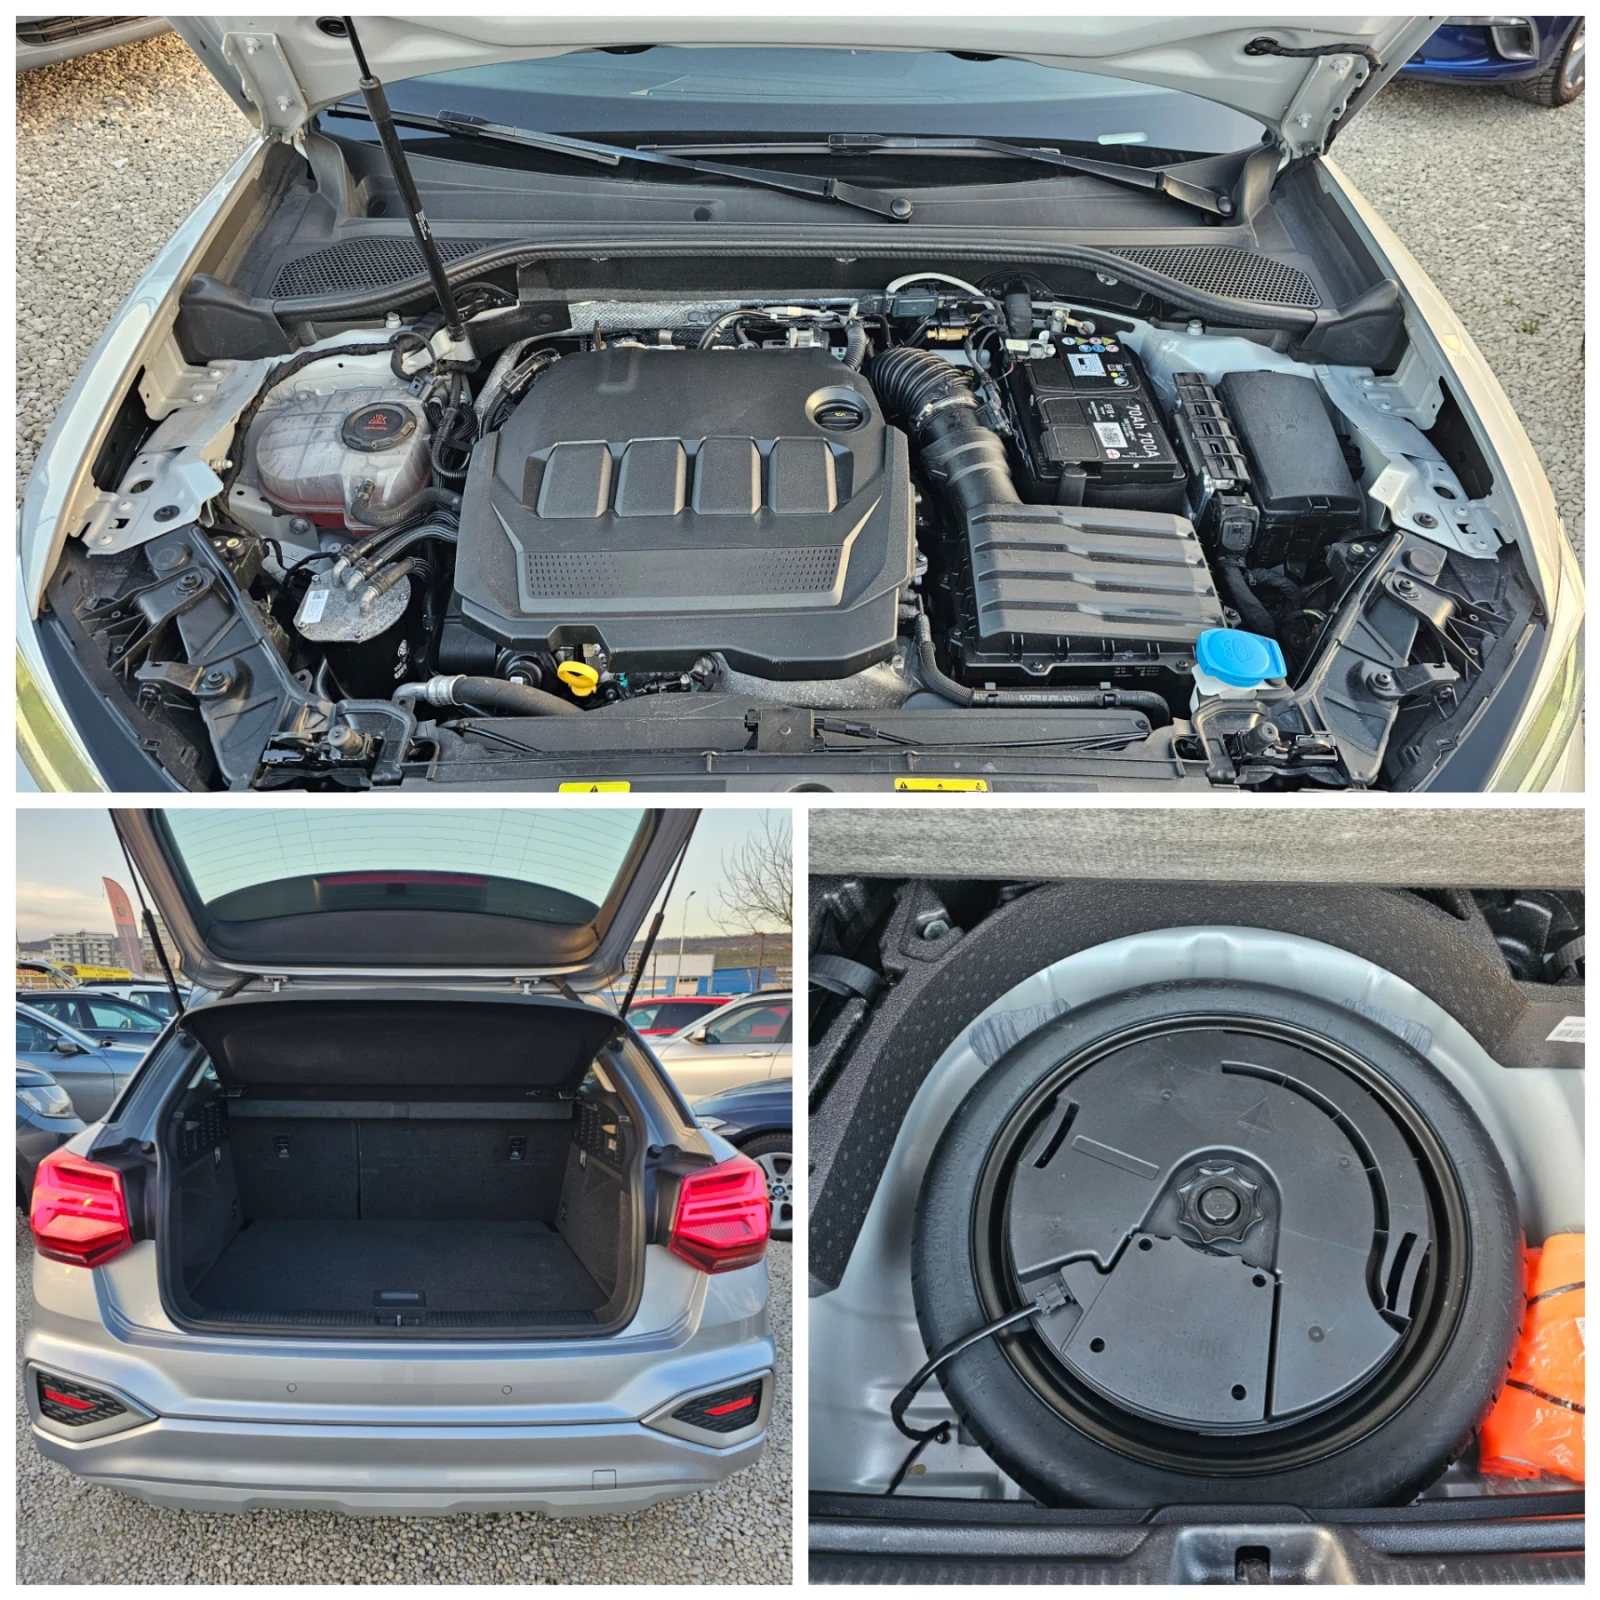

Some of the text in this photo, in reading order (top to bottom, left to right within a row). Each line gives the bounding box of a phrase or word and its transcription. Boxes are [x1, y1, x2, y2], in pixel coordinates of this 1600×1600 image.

[1126, 404, 1148, 430] 70Ah
[1138, 432, 1160, 458] 700A
[1120, 978, 1228, 1004] S300
[1491, 1186, 1511, 1236] USE
[1494, 1246, 1514, 1315] ONLY
